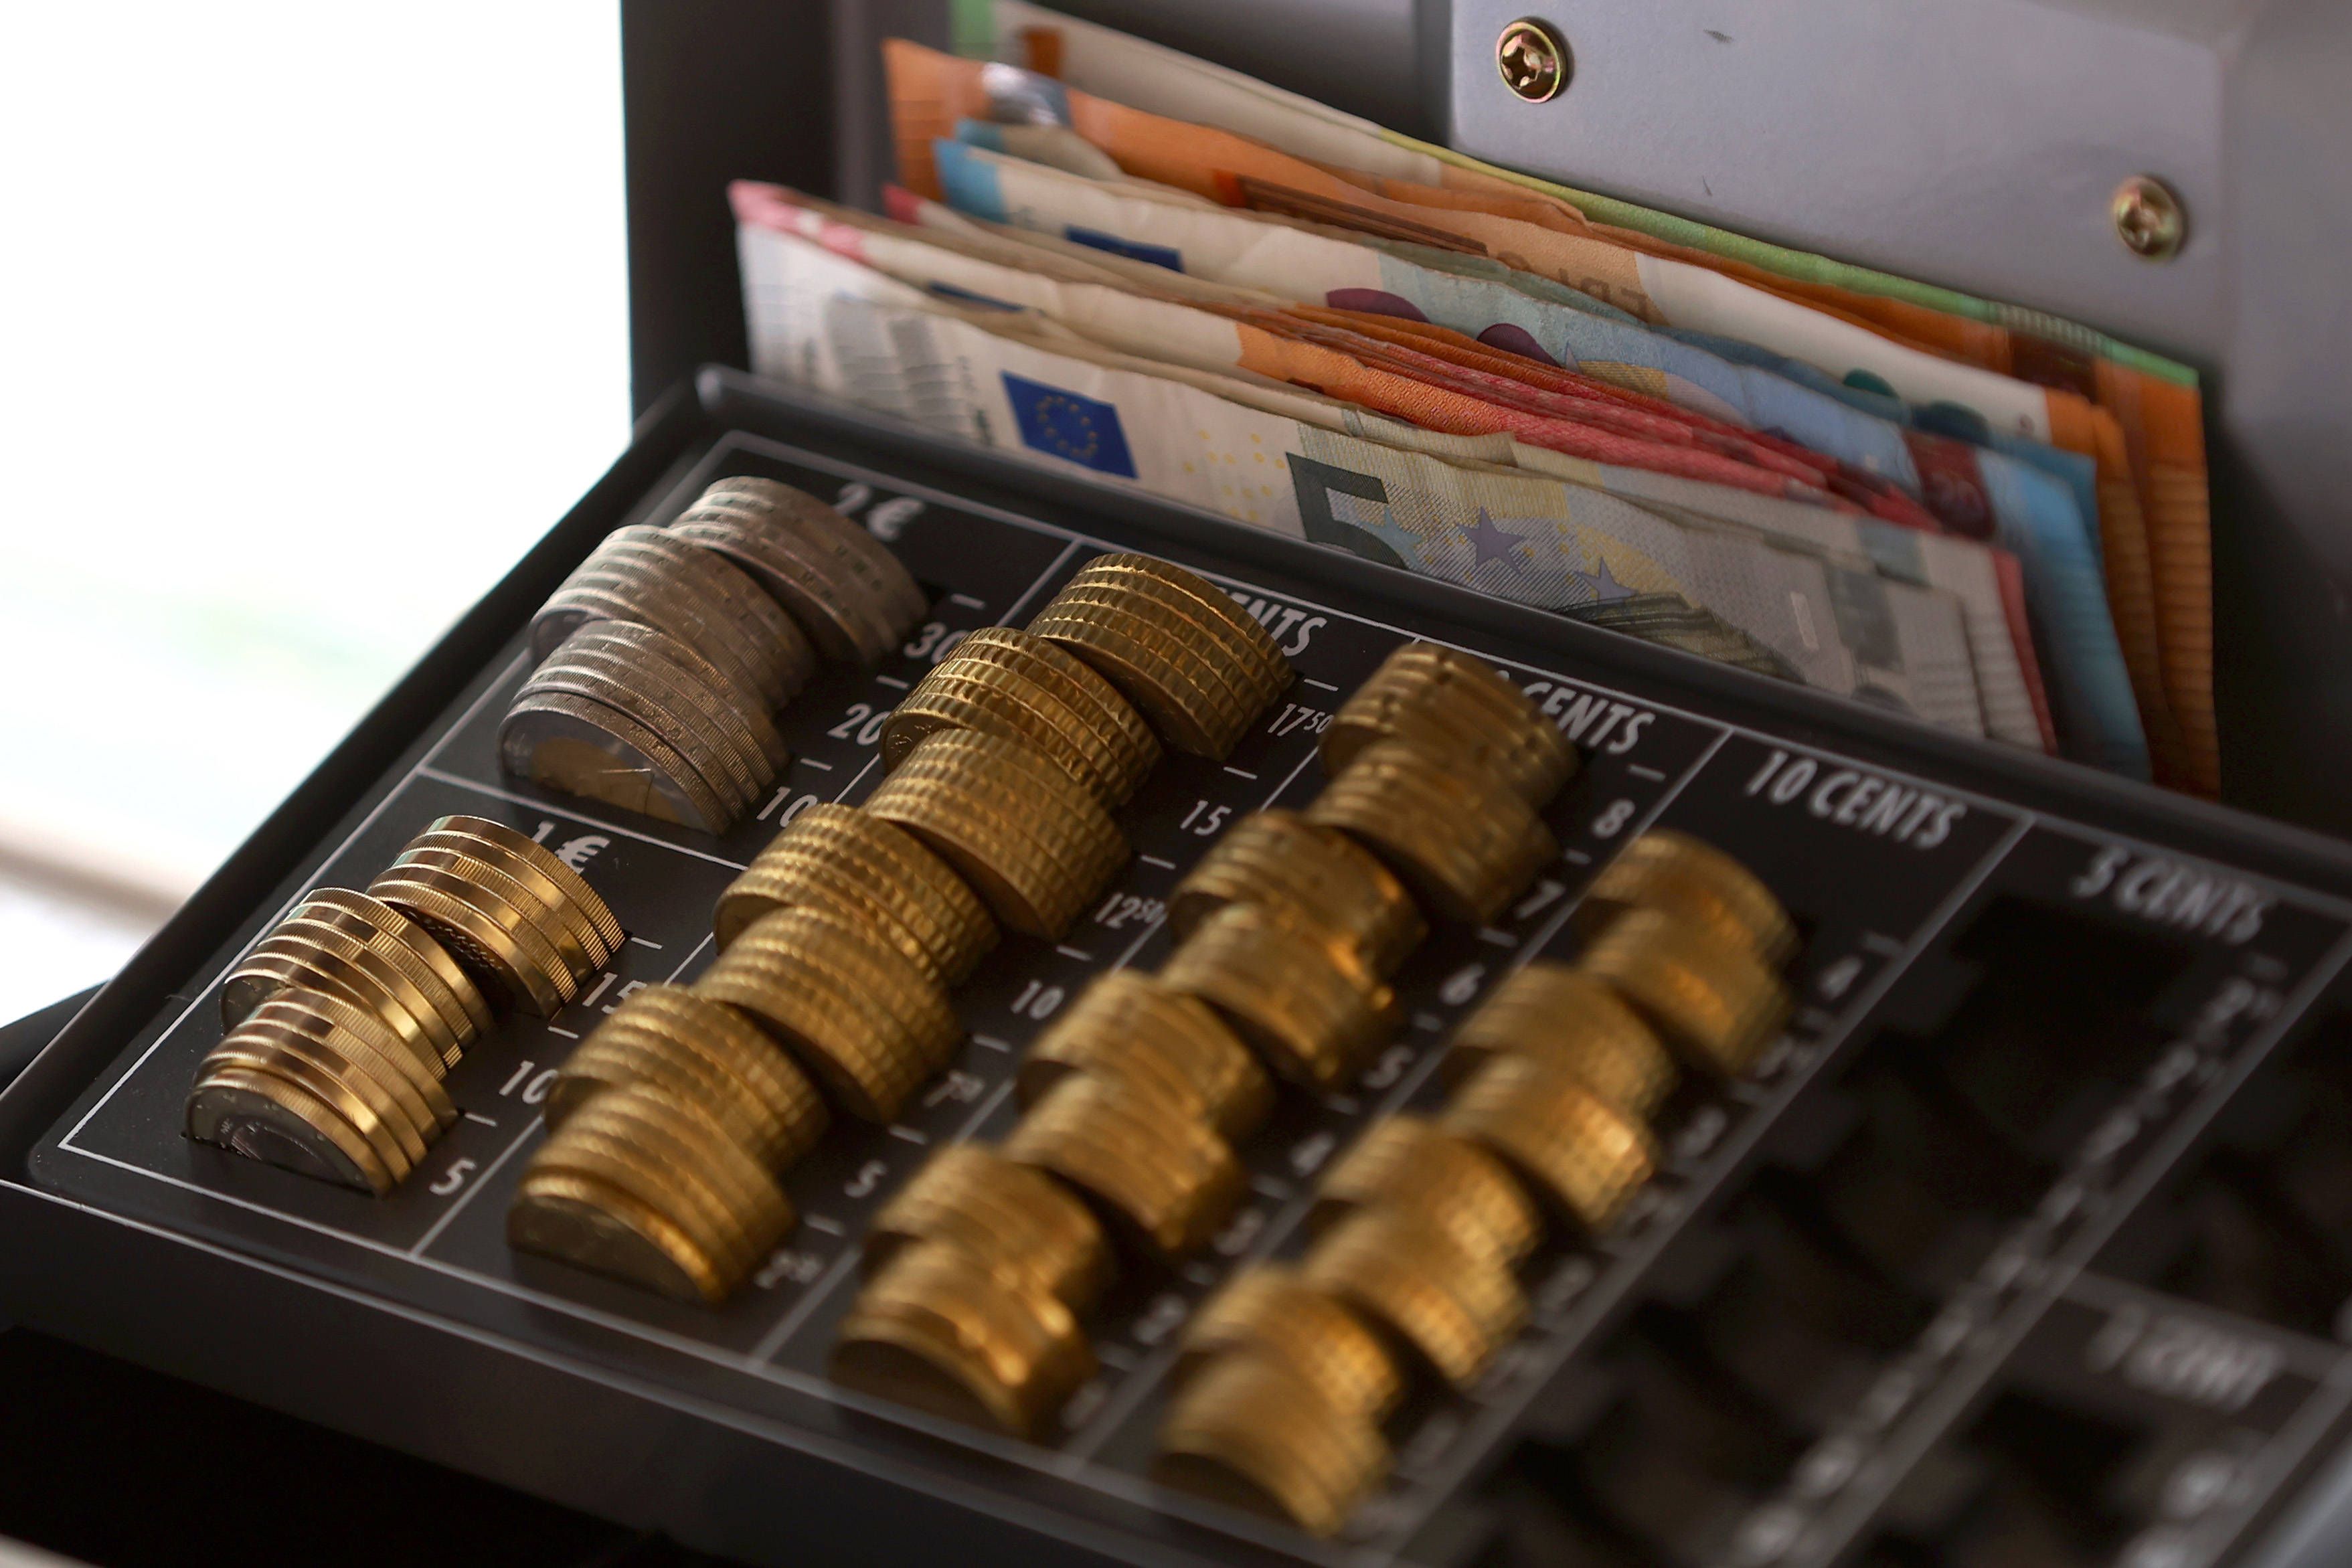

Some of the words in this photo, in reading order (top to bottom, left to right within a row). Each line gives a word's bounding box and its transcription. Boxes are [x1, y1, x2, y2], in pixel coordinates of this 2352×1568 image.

[1217, 586, 1328, 657] NTS
[827, 703, 891, 745] 20
[756, 786, 818, 828] 10
[1180, 800, 1232, 837] 15
[1591, 799, 1636, 838] 8
[1746, 750, 1818, 804] 10
[1811, 770, 1968, 849] CENTS
[2116, 859, 2268, 943] CENTS
[583, 972, 647, 1015] 15
[1010, 979, 1065, 1020] 10
[499, 1060, 560, 1104] 10
[430, 1158, 476, 1196] 5
